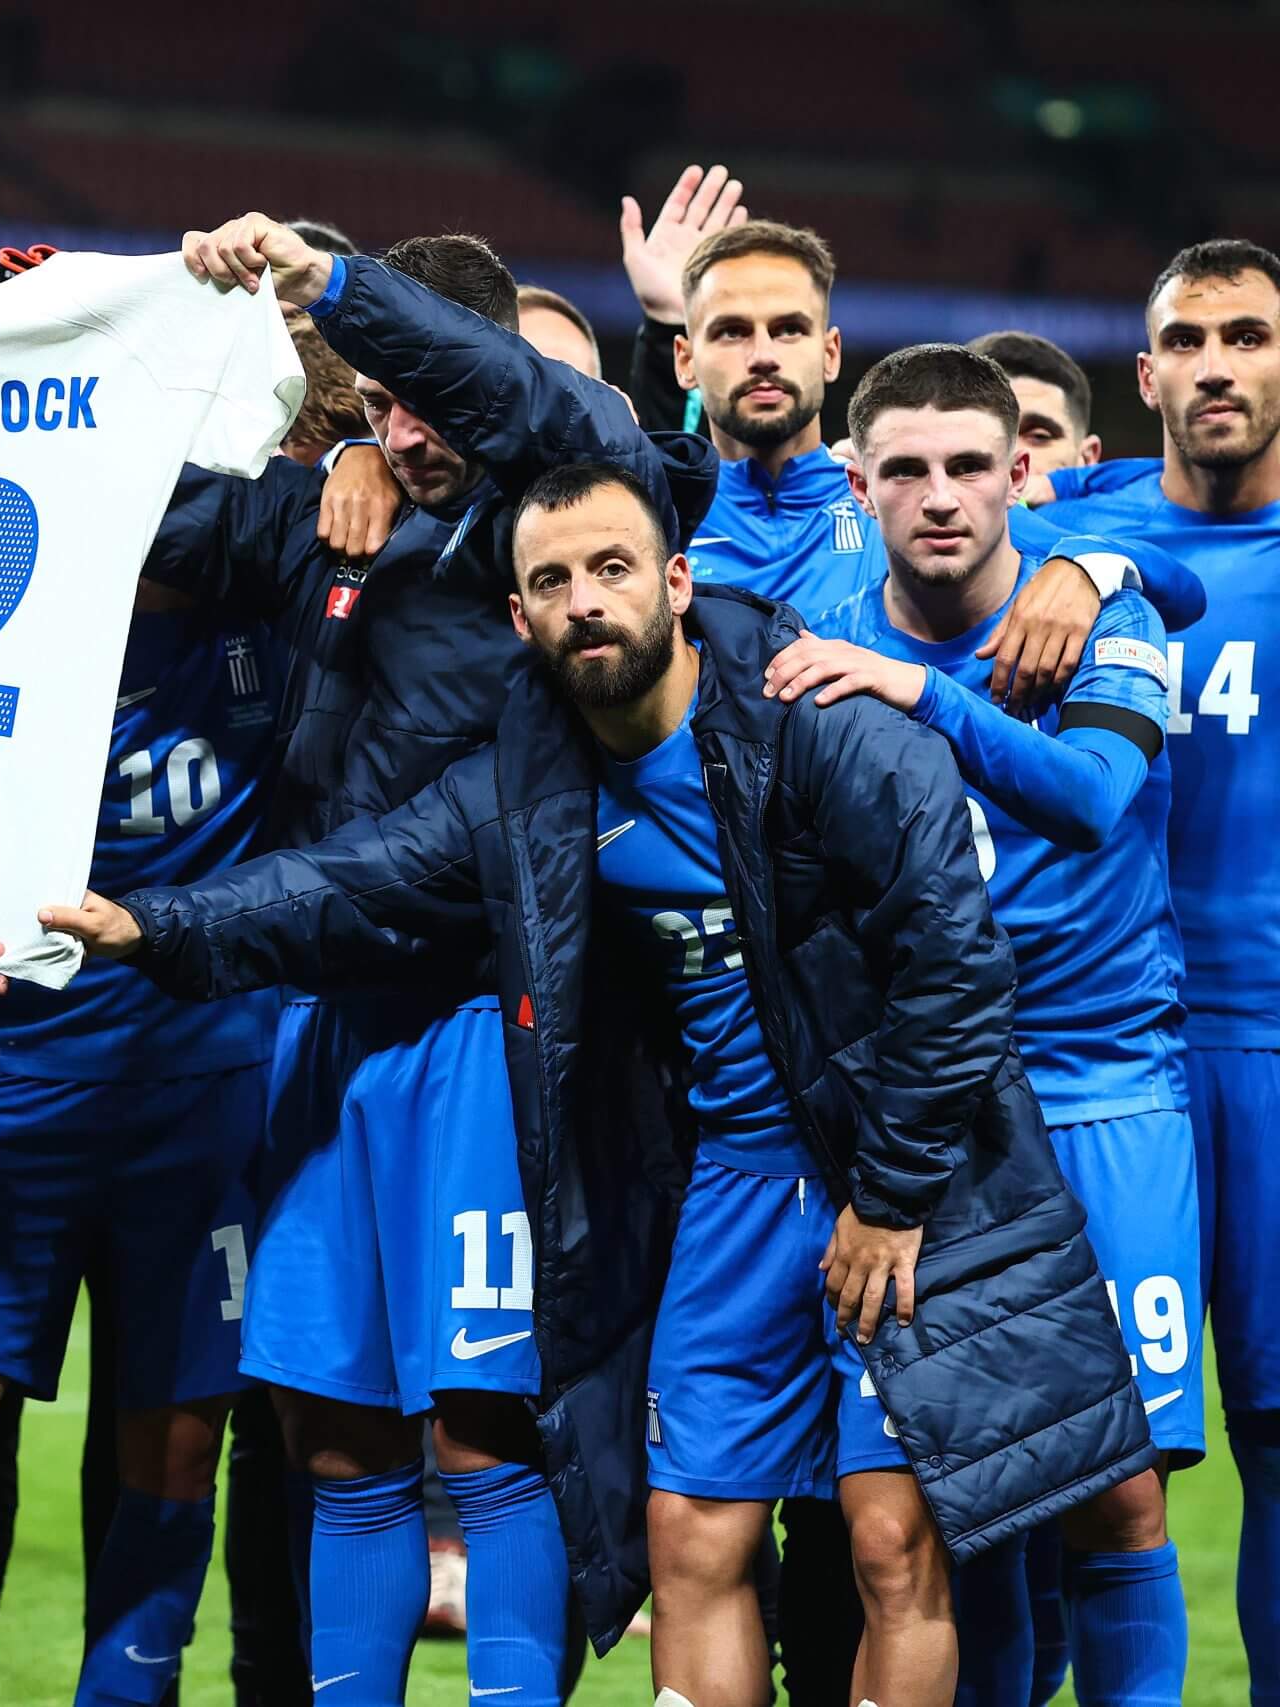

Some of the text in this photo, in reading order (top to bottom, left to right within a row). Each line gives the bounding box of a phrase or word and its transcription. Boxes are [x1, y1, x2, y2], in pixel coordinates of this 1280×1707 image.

[1166, 641, 1260, 735] 14
[118, 737, 222, 834] 10
[451, 1210, 534, 1311] 11
